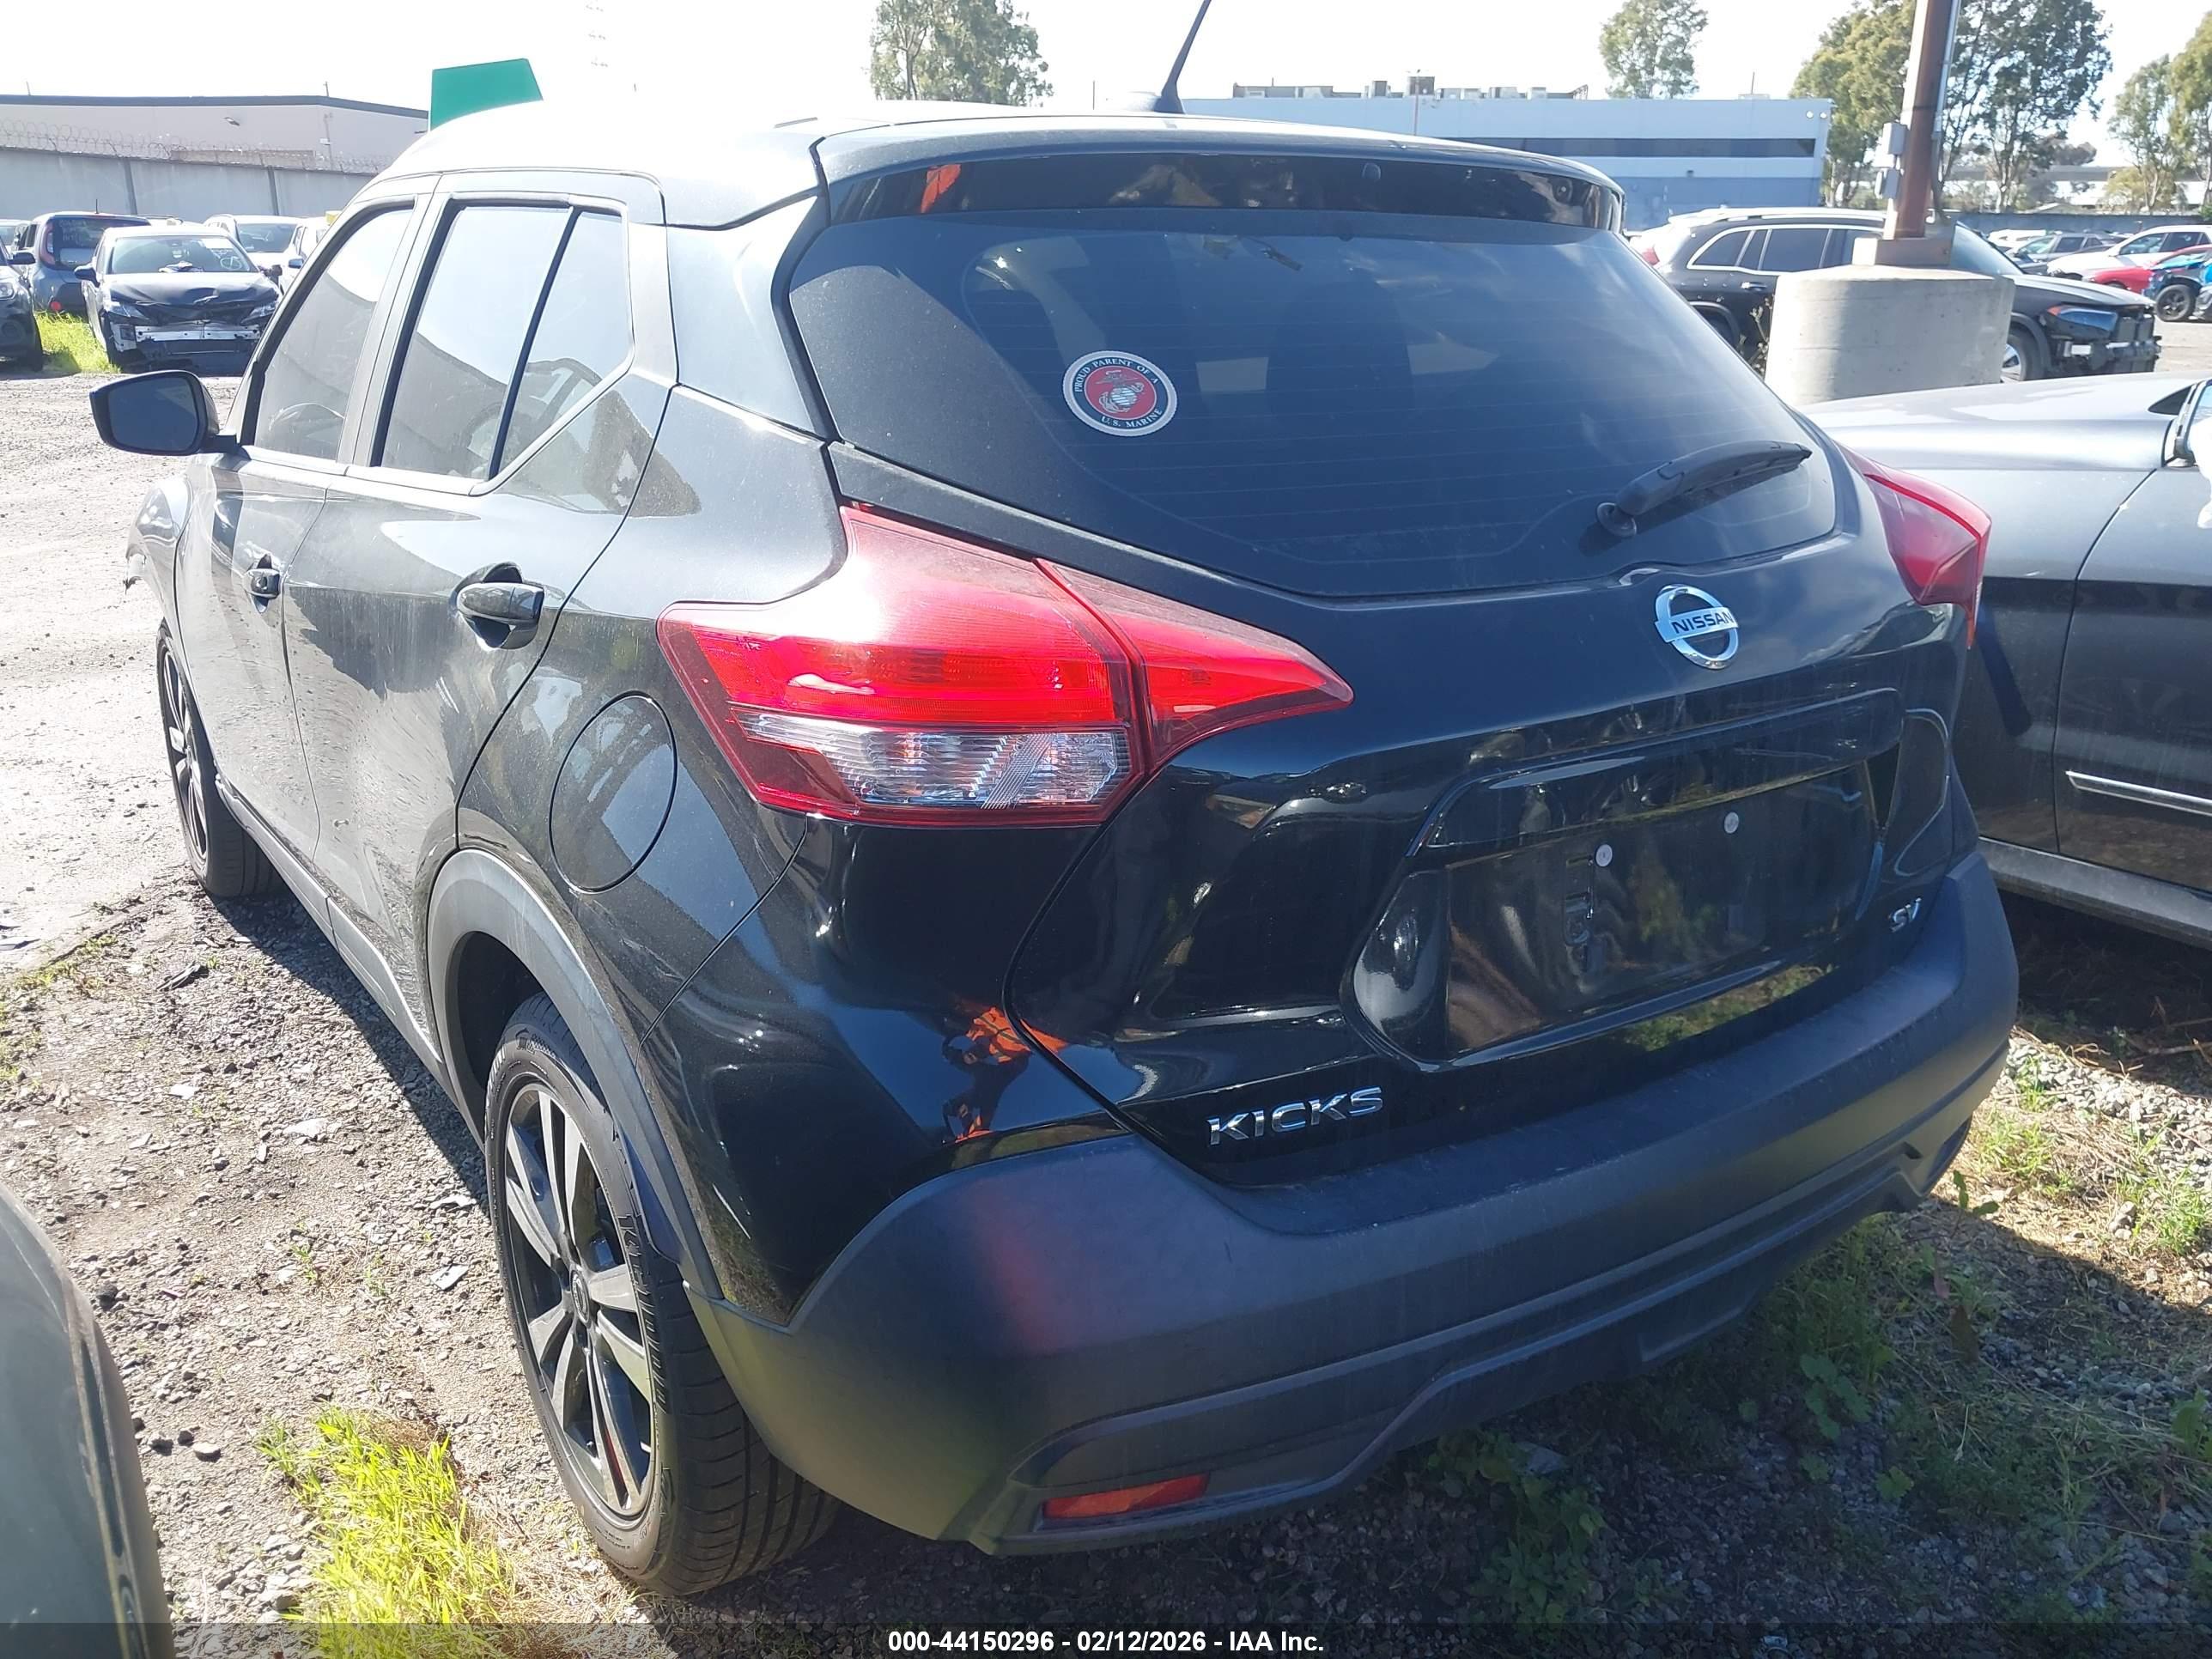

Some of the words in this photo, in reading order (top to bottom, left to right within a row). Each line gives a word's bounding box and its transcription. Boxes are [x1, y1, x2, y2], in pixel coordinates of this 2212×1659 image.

[1074, 367, 1091, 392] PROUD
[1092, 358, 1133, 368] PARENT
[1136, 365, 1150, 375] OF
[1125, 408, 1163, 428] MARINE
[1670, 611, 1735, 634] NISSAN
[1890, 897, 1923, 933] SV
[1206, 1085, 1384, 1146] KICKS
